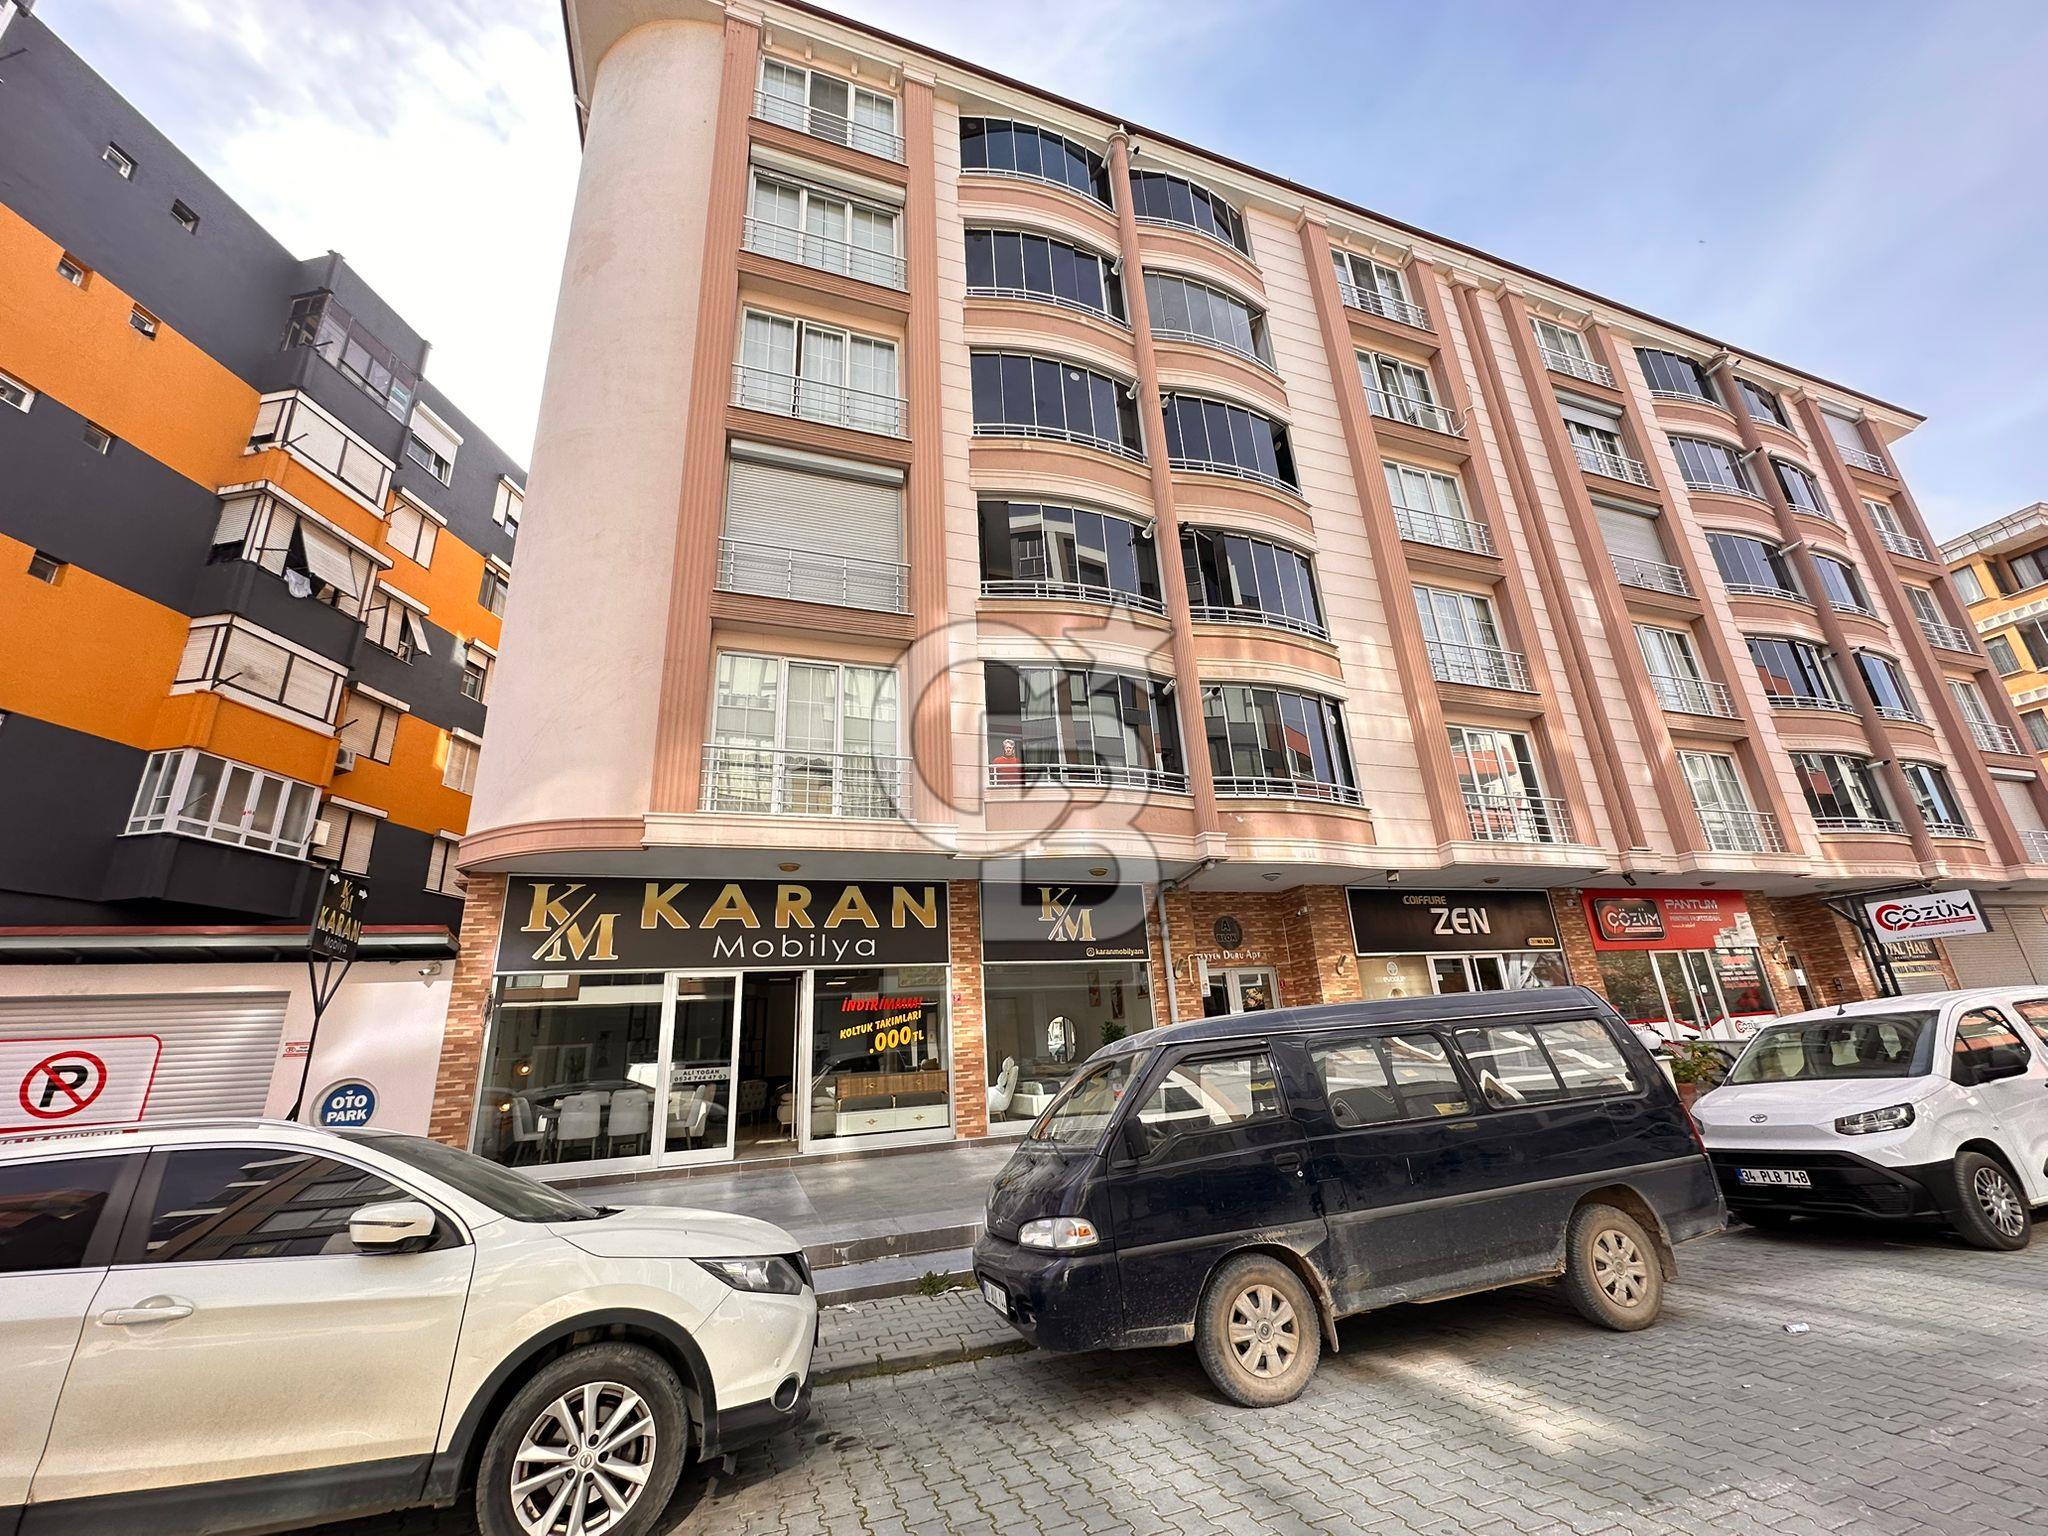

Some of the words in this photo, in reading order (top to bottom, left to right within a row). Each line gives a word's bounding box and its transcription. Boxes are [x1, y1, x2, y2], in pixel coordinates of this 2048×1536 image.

[640, 882, 938, 929] KARAN
[1402, 895, 1448, 905] COIFFURE
[317, 905, 362, 943] KARAN
[1429, 907, 1491, 935] ZEN
[1607, 907, 1661, 934] ÇÖZÜM
[1884, 899, 1975, 932] ÇÖZÜM
[711, 932, 878, 962] Mobilya
[840, 1022, 873, 1039] KOLTUK
[875, 1010, 922, 1030] TAKIMLARI
[912, 1030, 924, 1042] TL
[326, 1108, 368, 1123] PARK
[331, 1094, 368, 1110] OTO
[1742, 1170, 1757, 1182] 34
